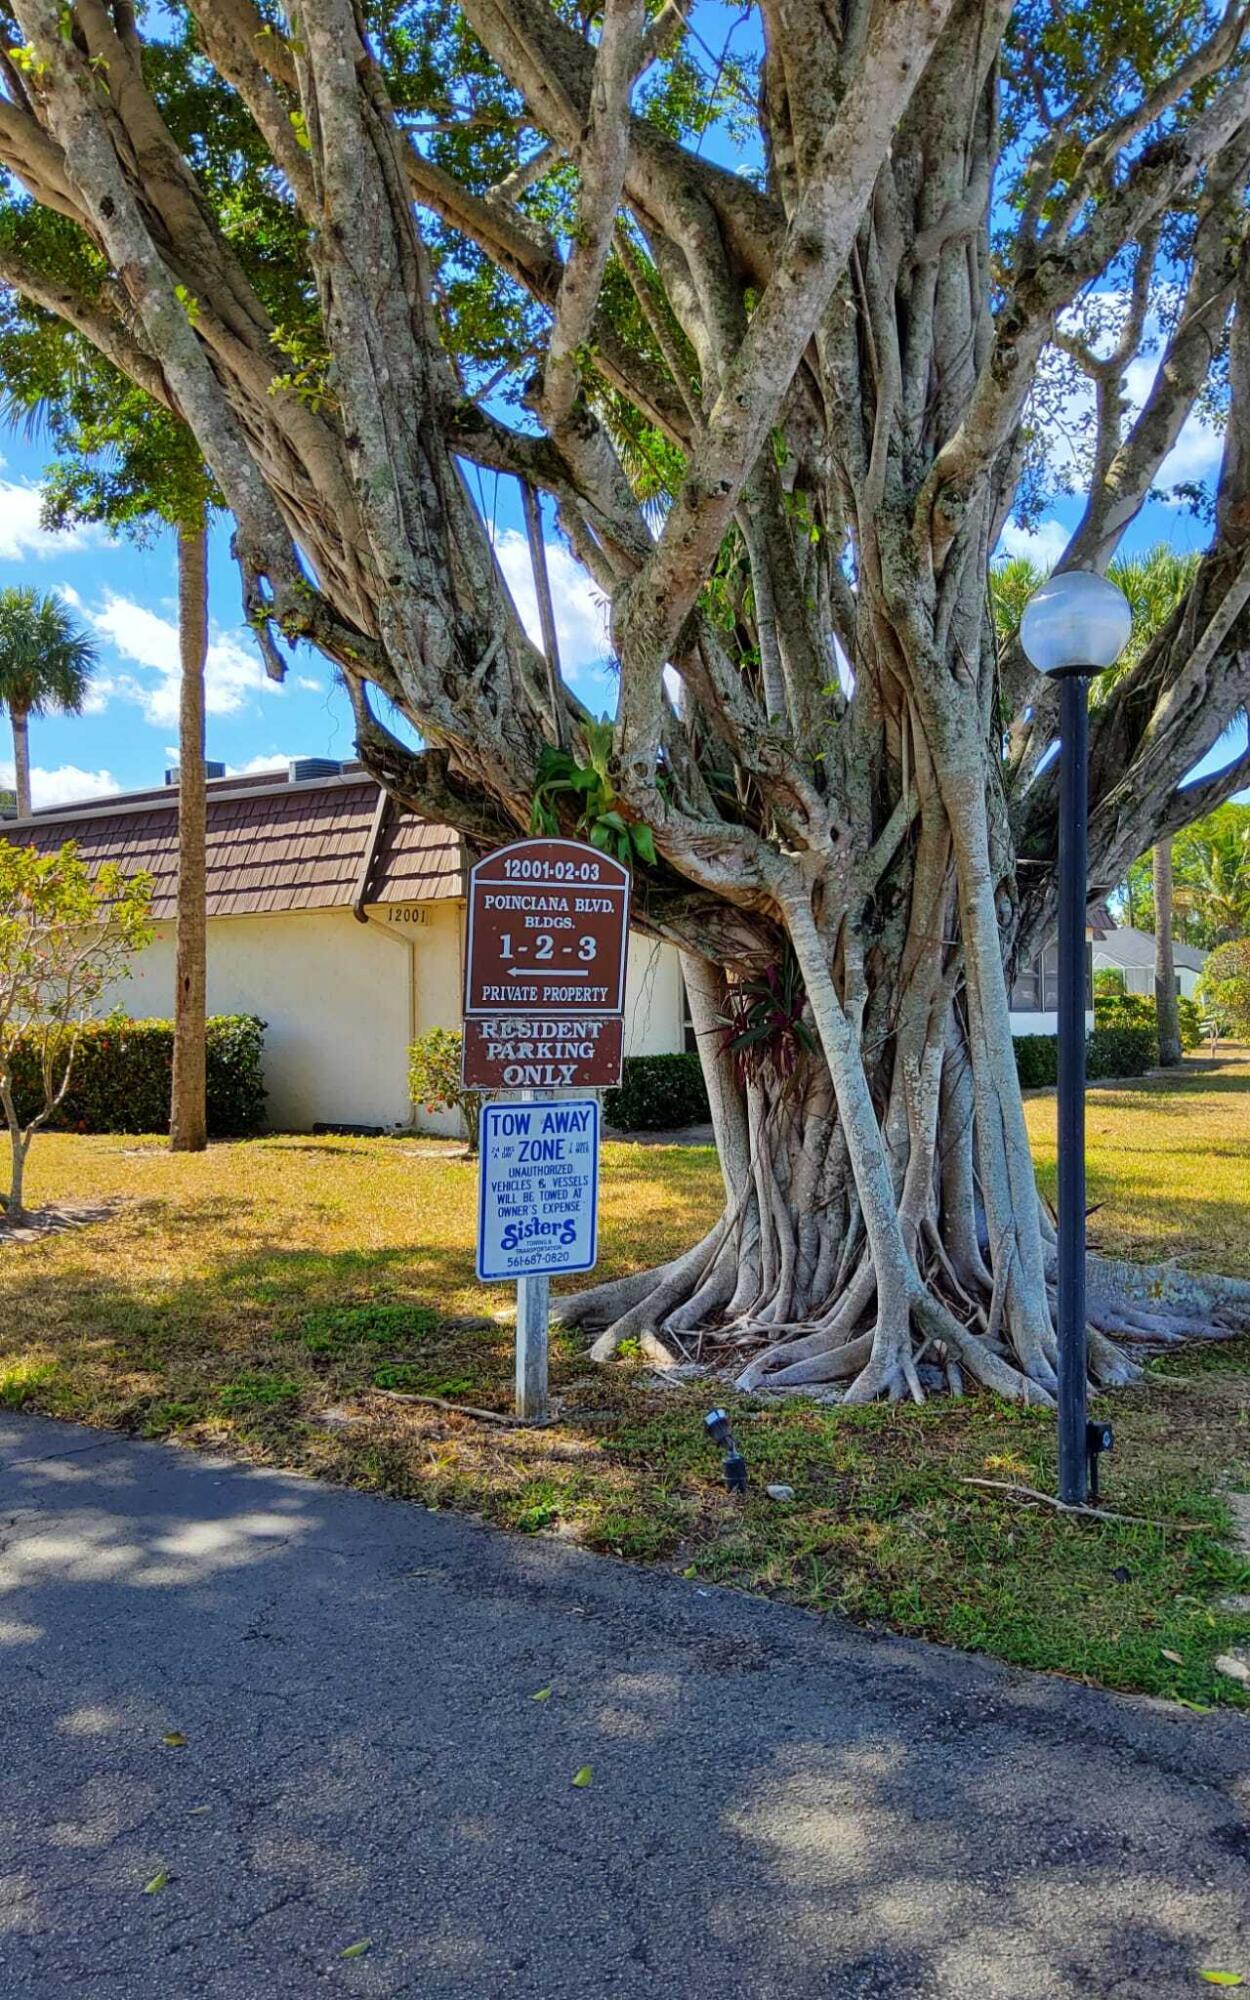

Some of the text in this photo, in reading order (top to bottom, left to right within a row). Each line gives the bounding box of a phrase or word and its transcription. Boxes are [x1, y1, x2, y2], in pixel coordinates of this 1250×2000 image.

[504, 859, 600, 881] 12001-02-03
[484, 895, 615, 913] POINCIANA BLVD.
[388, 907, 425, 923] 12001
[524, 916, 576, 929] BLDGS.
[482, 986, 609, 1002] PRIVATE PROPERTY
[480, 1021, 604, 1039] RESIDENT
[487, 1042, 596, 1060] PARKING
[503, 1065, 579, 1086] ONLY
[491, 1110, 591, 1137] TOW AWAY
[518, 1139, 566, 1163] ZONE
[509, 1164, 573, 1178] UNAUTHORIZED
[491, 1176, 588, 1192] VEHICLES & VESSELS
[497, 1188, 582, 1205] WILL BE TOWED AT
[498, 1202, 580, 1217] OWNER'S EXPENSE
